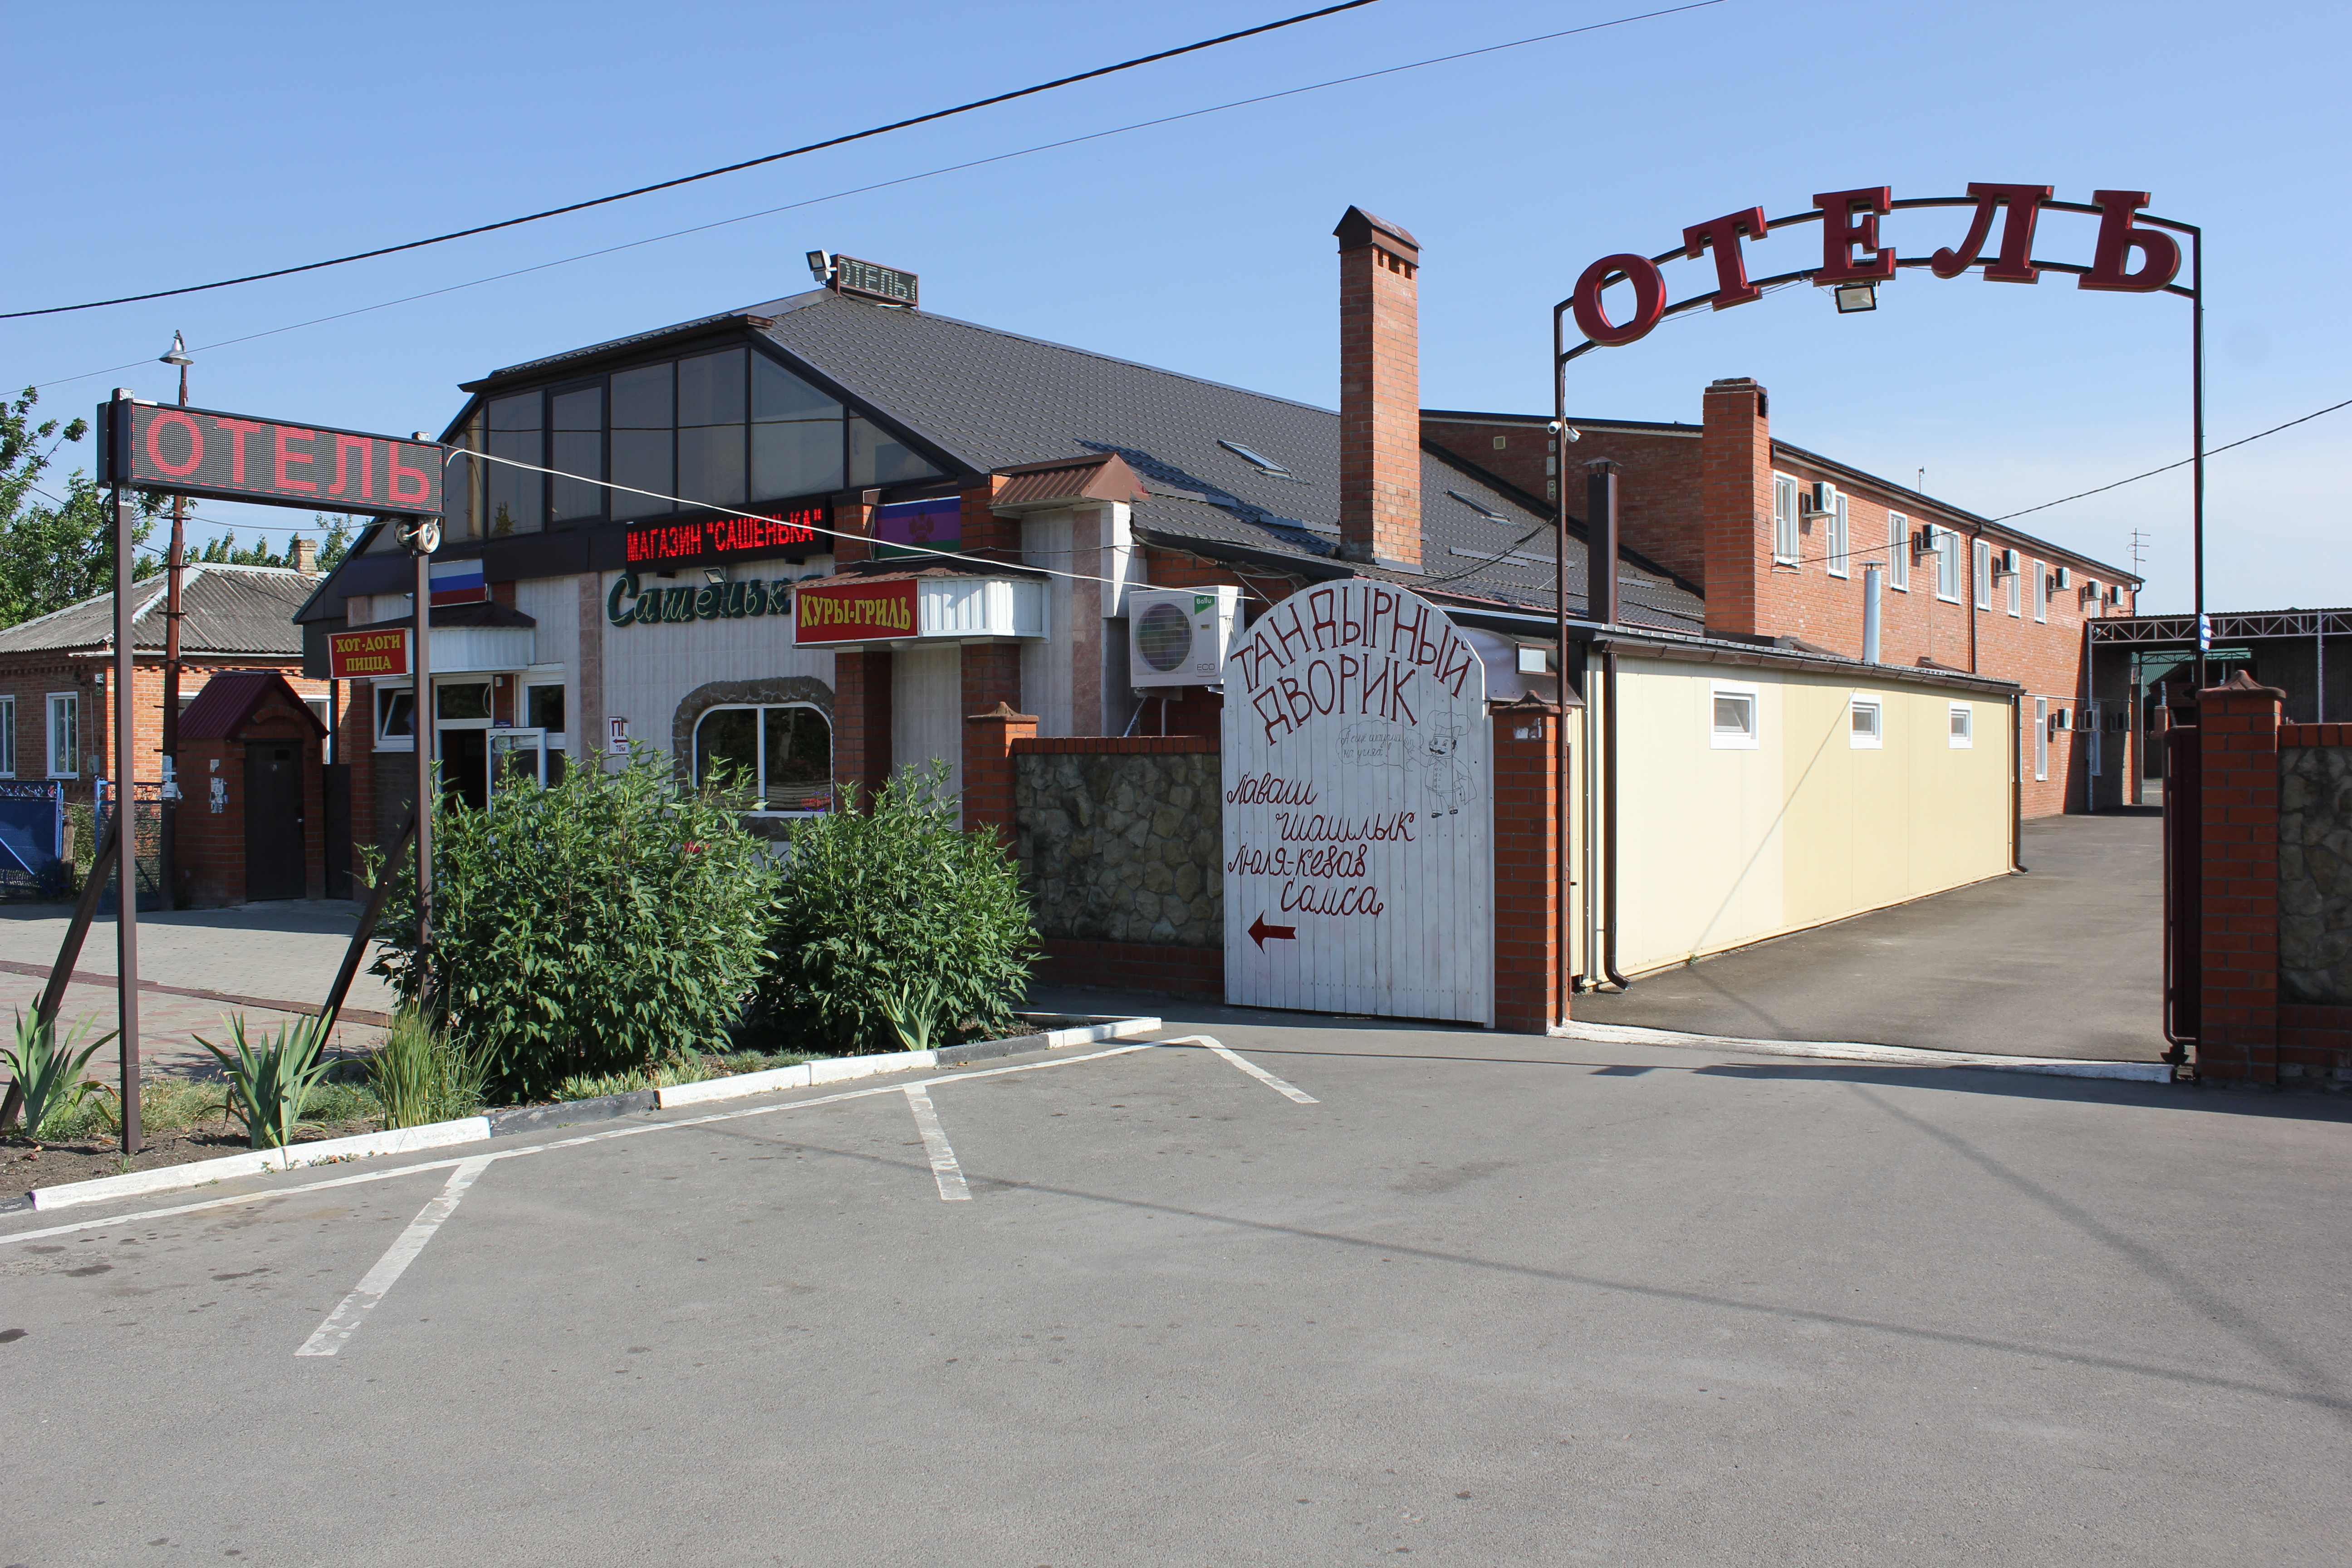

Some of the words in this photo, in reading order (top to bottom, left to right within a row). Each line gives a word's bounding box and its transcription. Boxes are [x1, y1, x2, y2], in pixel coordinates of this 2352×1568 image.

[1573, 182, 2181, 347] ОТЕЛЬ
[146, 410, 430, 504] ОТЕЛЬ
[627, 524, 701, 562] МАГАЗИН
[706, 508, 822, 551] "САШЕНЬКА"
[800, 594, 911, 630] КУРЫ-ГРИЛЬ
[336, 635, 401, 652] ХОТ-ДОГИ
[1230, 586, 1473, 699] ТАНДЫРНЫЙ
[346, 656, 392, 672] ПИЦЦА
[1252, 653, 1418, 746] ДВОРИК
[1226, 771, 1318, 807] Лаваш
[1228, 843, 1367, 879] Люля-кебаб
[1280, 877, 1384, 919] Самса
